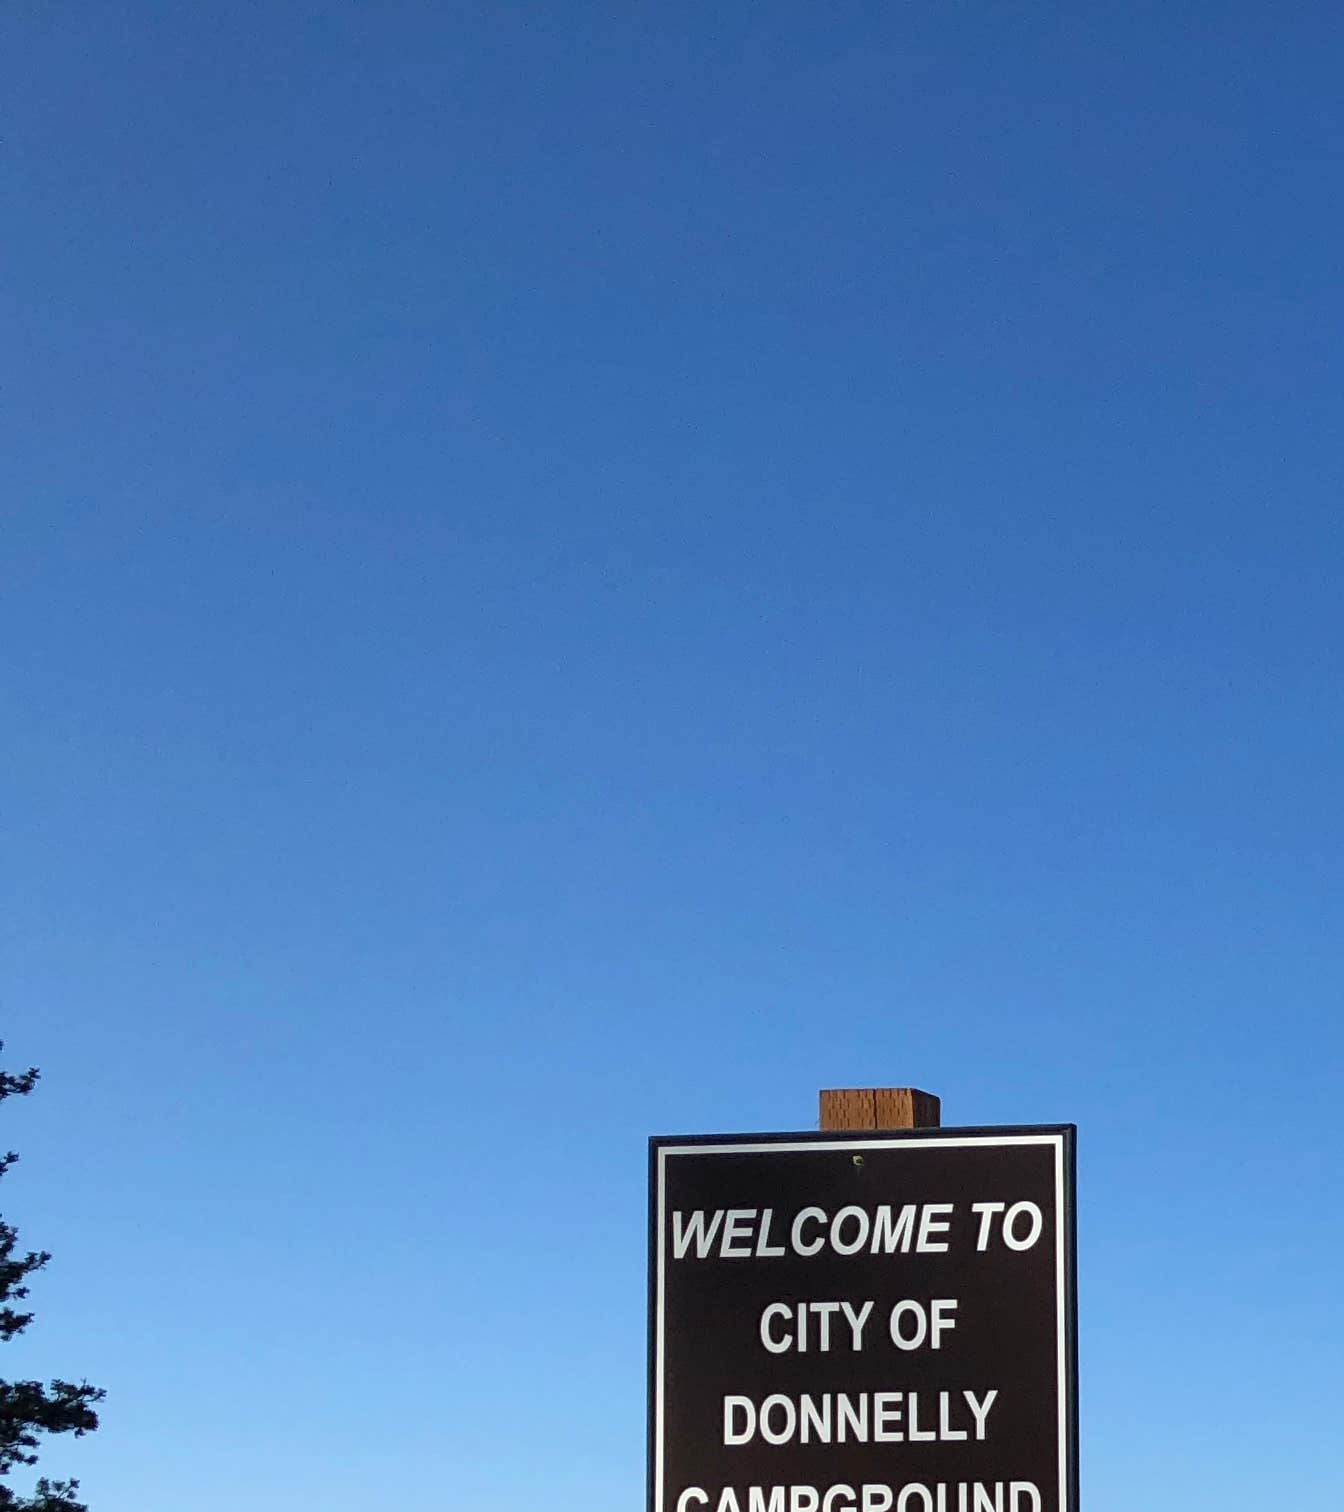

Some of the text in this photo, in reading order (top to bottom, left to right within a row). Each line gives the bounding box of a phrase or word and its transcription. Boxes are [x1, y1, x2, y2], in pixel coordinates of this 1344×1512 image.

[672, 1200, 1043, 1259] WELCOME TO
[760, 1299, 958, 1354] CITY OF
[723, 1389, 999, 1446] DONNELLY
